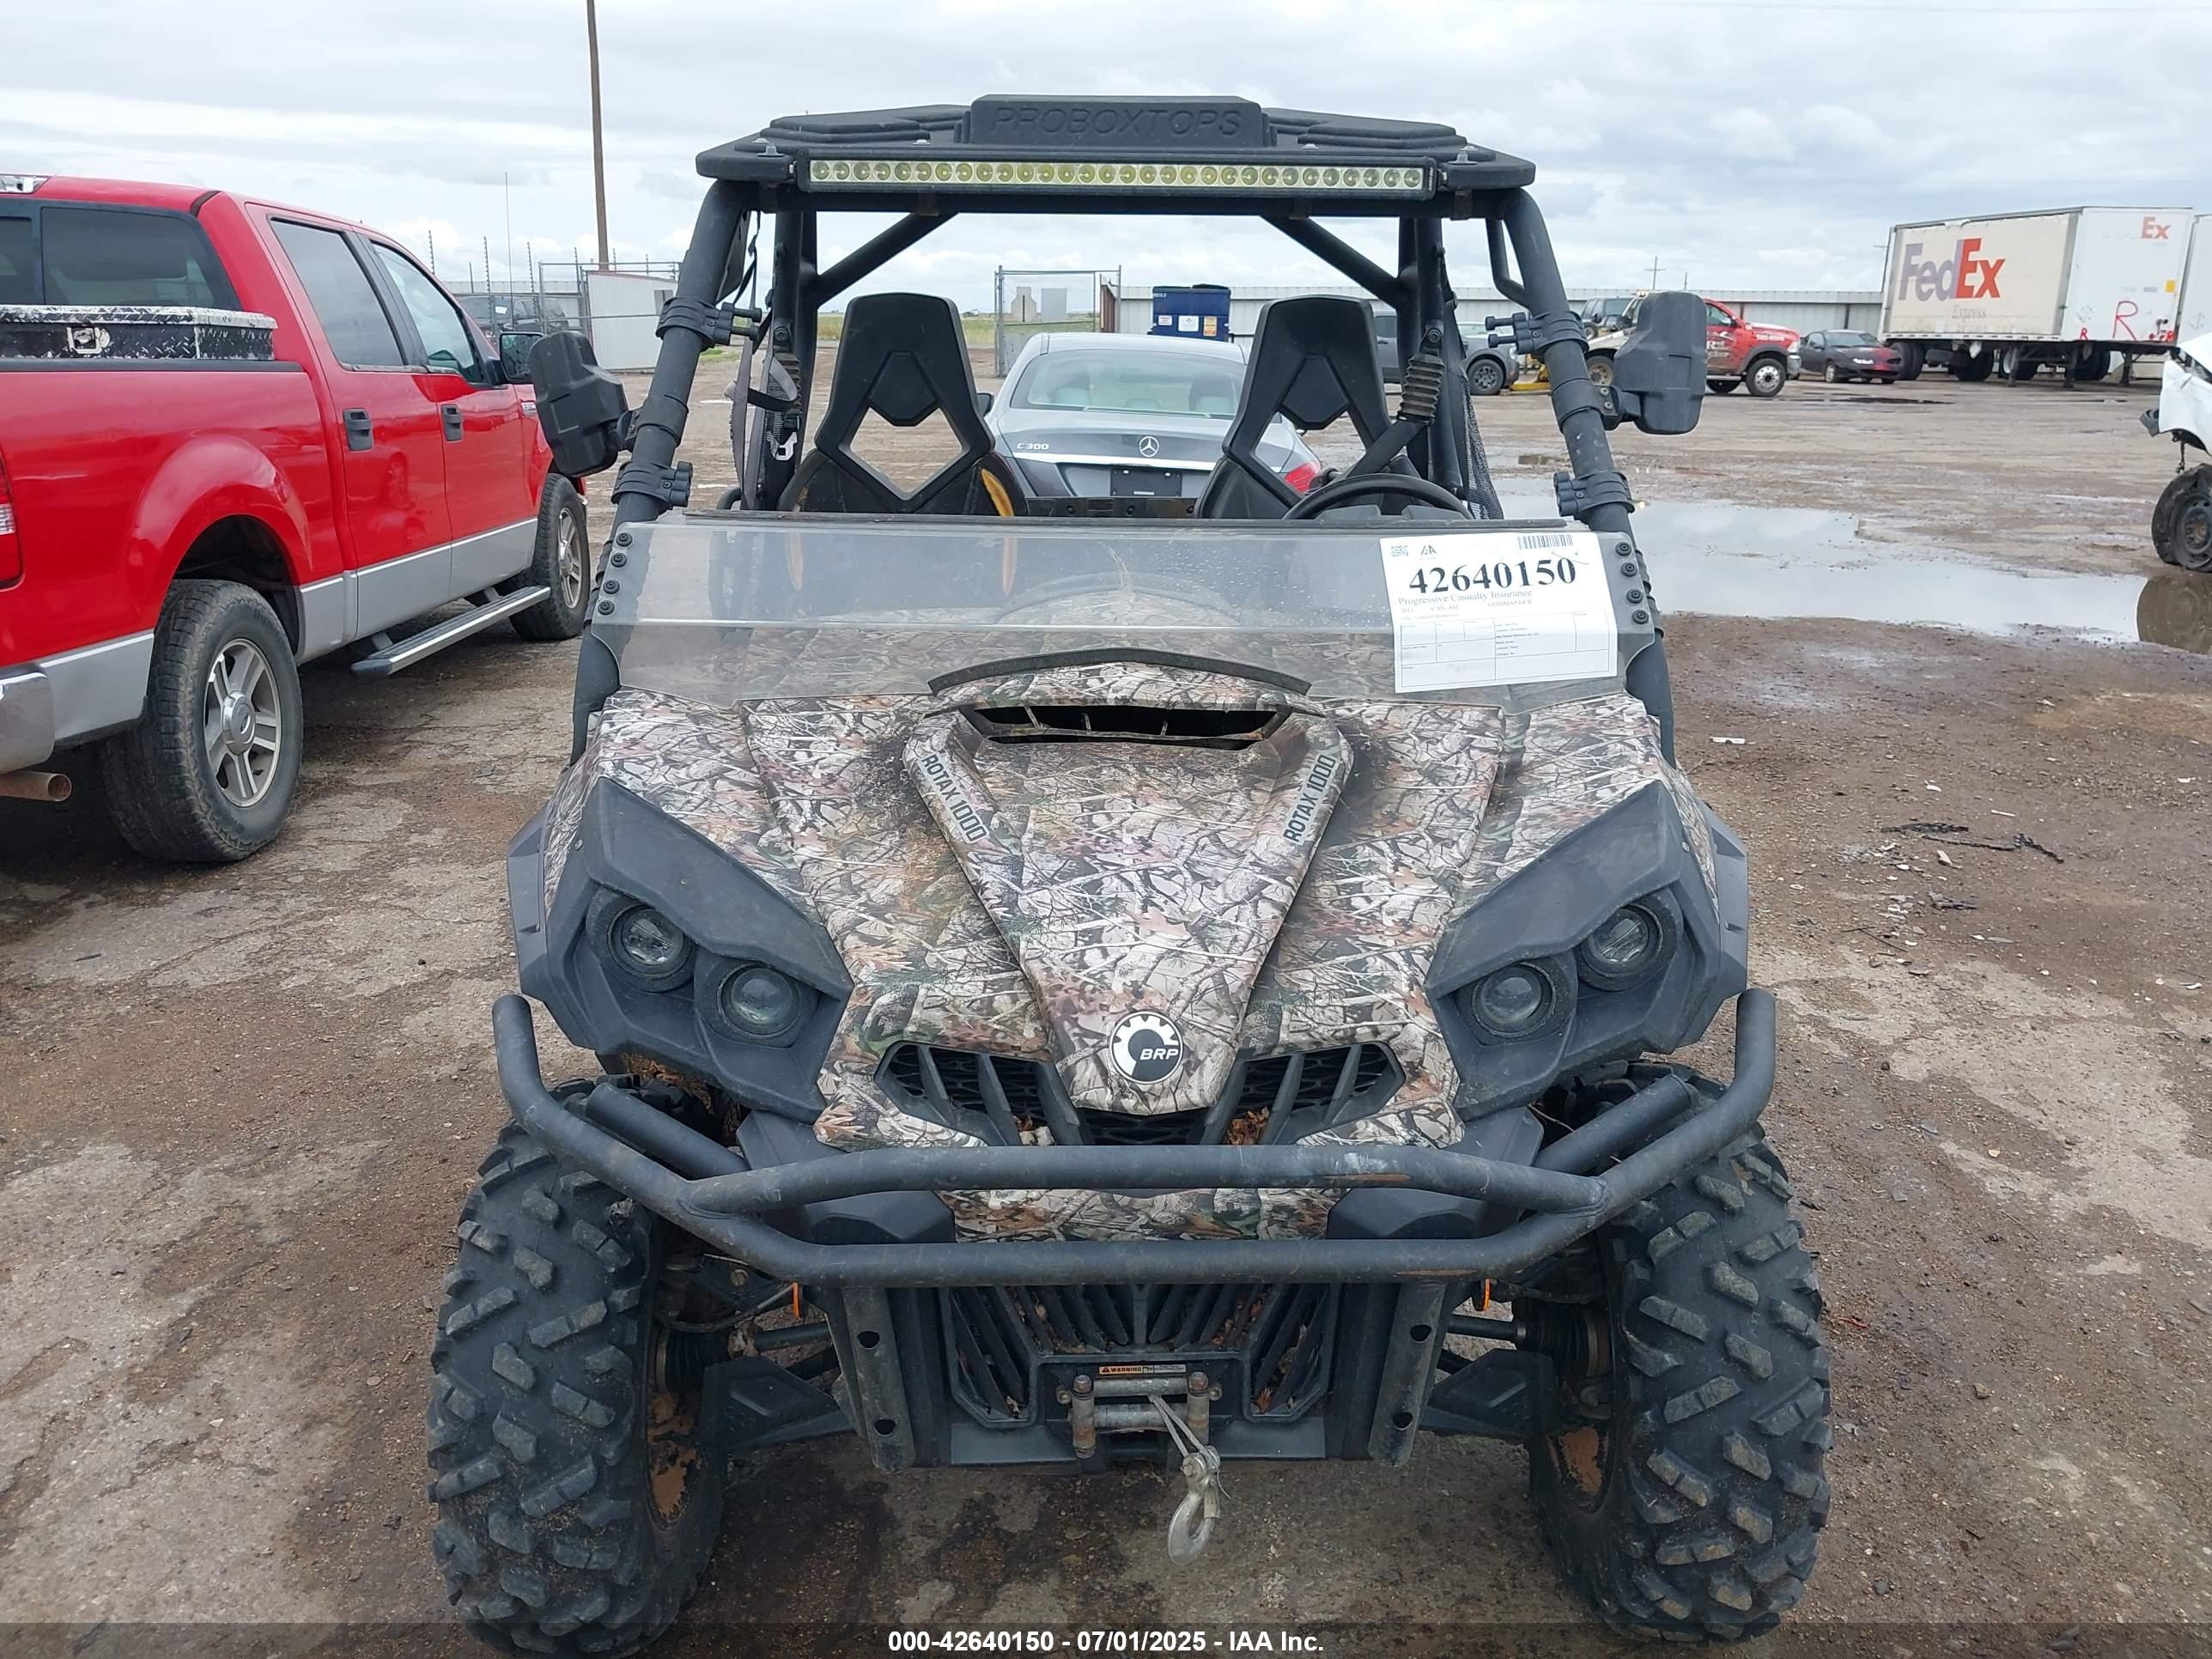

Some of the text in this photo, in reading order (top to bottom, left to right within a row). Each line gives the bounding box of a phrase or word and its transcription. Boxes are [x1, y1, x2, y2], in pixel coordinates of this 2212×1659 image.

[990, 106, 1243, 137] PROBOXTOPS
[2142, 216, 2172, 240] Ex
[1898, 237, 2006, 301] FedEx
[2113, 300, 2138, 343] R
[1409, 557, 1577, 594] 42640150
[1398, 589, 1532, 606] Progressive Casualty Insurance
[921, 754, 988, 842] ROTAX 1000
[1283, 755, 1336, 842] ROTAX 1000
[1139, 1048, 1179, 1060] BRP
